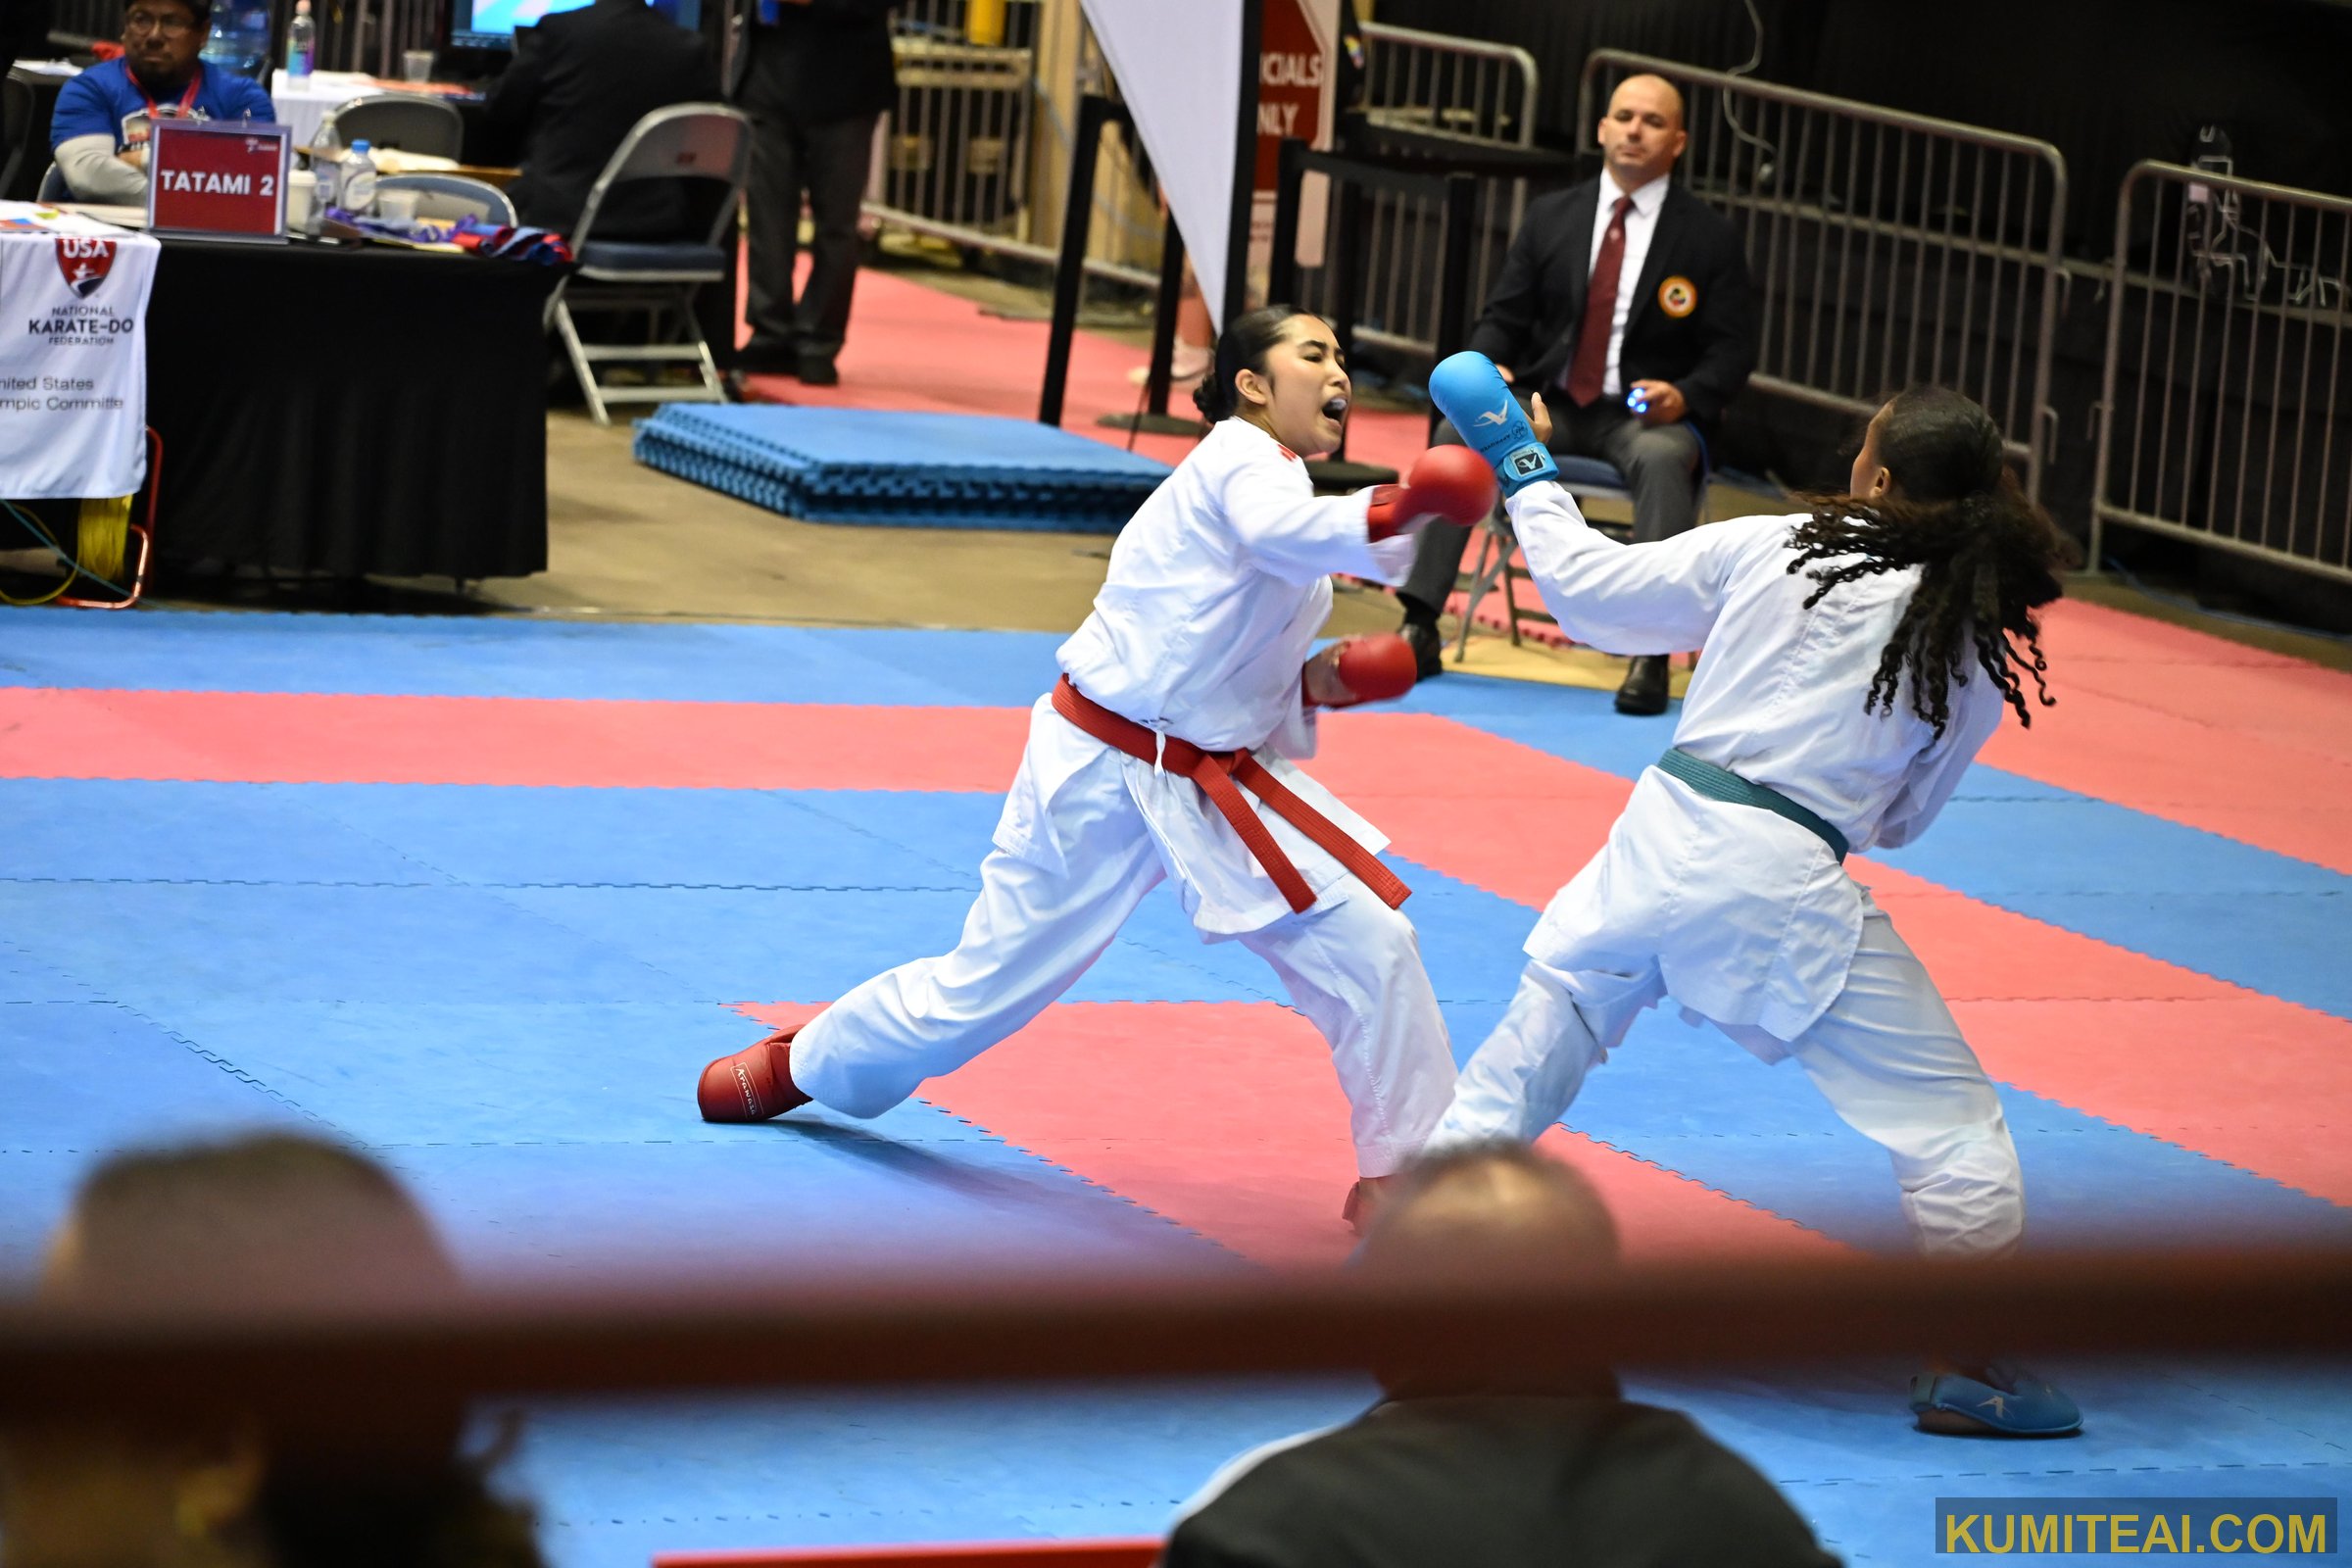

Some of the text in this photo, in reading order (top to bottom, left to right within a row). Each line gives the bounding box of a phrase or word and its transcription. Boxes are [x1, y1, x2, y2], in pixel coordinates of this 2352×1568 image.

[161, 170, 274, 196] TATAMI 2
[63, 238, 109, 258] USA
[52, 305, 115, 317] NATIONAL
[28, 318, 133, 334] KARATE-DO
[49, 336, 114, 345] FEDERATION
[43, 376, 94, 391] States
